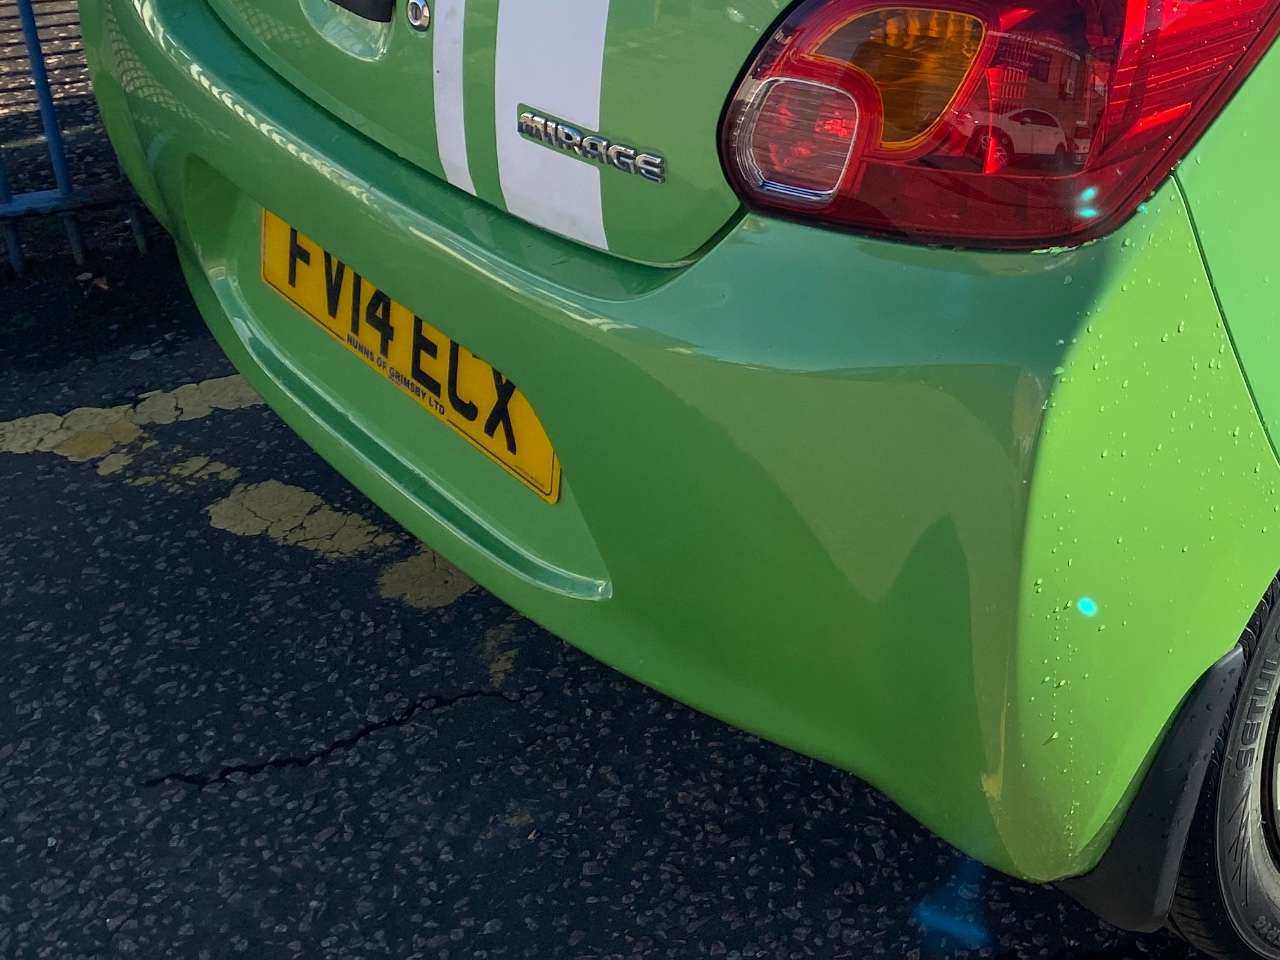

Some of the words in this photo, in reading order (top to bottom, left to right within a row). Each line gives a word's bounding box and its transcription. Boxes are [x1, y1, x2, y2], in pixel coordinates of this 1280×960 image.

[518, 111, 666, 184] MIRAGE
[287, 227, 394, 359] FV14
[411, 315, 517, 456] ECX
[428, 396, 446, 416] LTD
